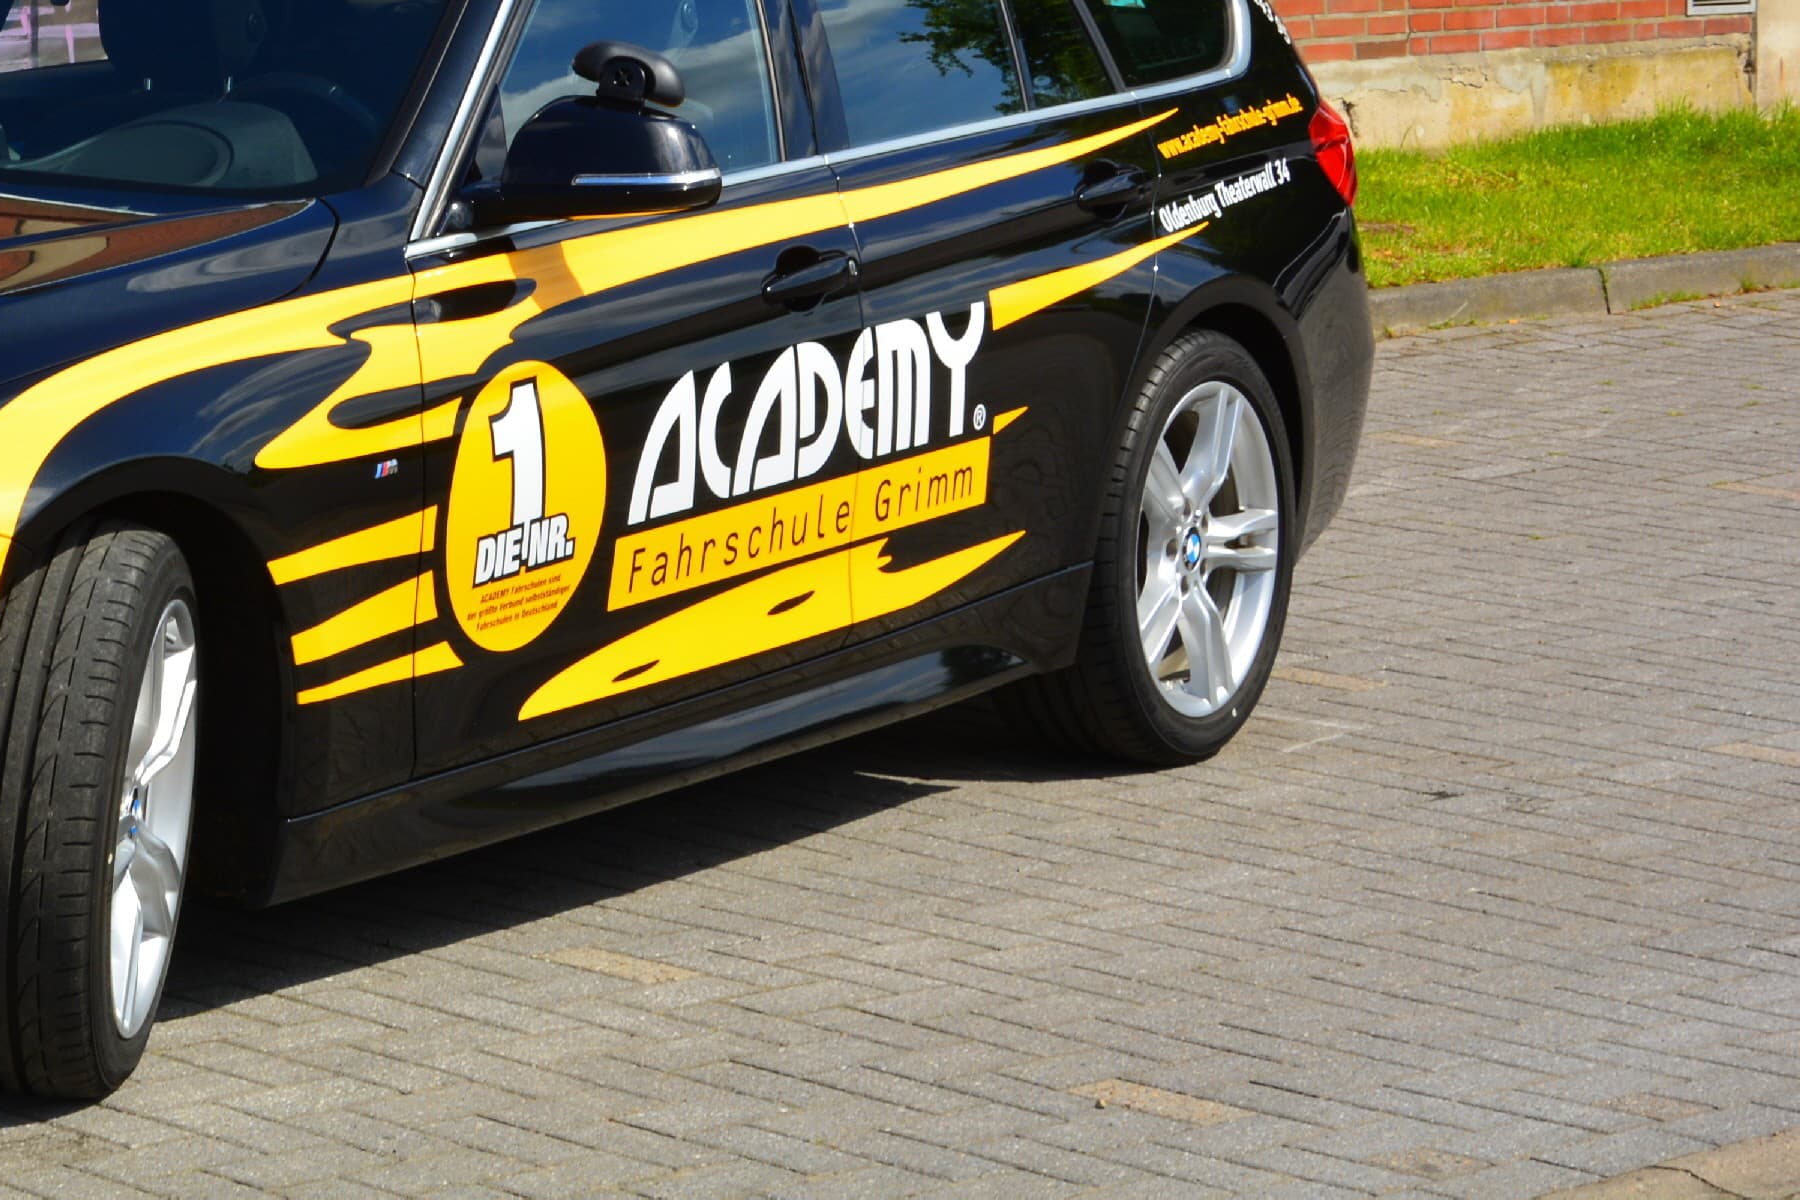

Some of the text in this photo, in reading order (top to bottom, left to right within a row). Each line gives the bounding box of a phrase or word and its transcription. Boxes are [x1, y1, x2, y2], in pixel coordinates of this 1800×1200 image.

[1159, 157, 1291, 233] Oldenburg Theaterwall 34
[488, 377, 546, 529] 1
[474, 514, 575, 587] DIE NR.
[628, 465, 974, 593] Fahrschule Grimm
[477, 615, 512, 631] Fahrschulen
[521, 601, 558, 618] Deutschland
[480, 588, 510, 603] ACADEMY
[512, 578, 547, 594] Fahrschulen
